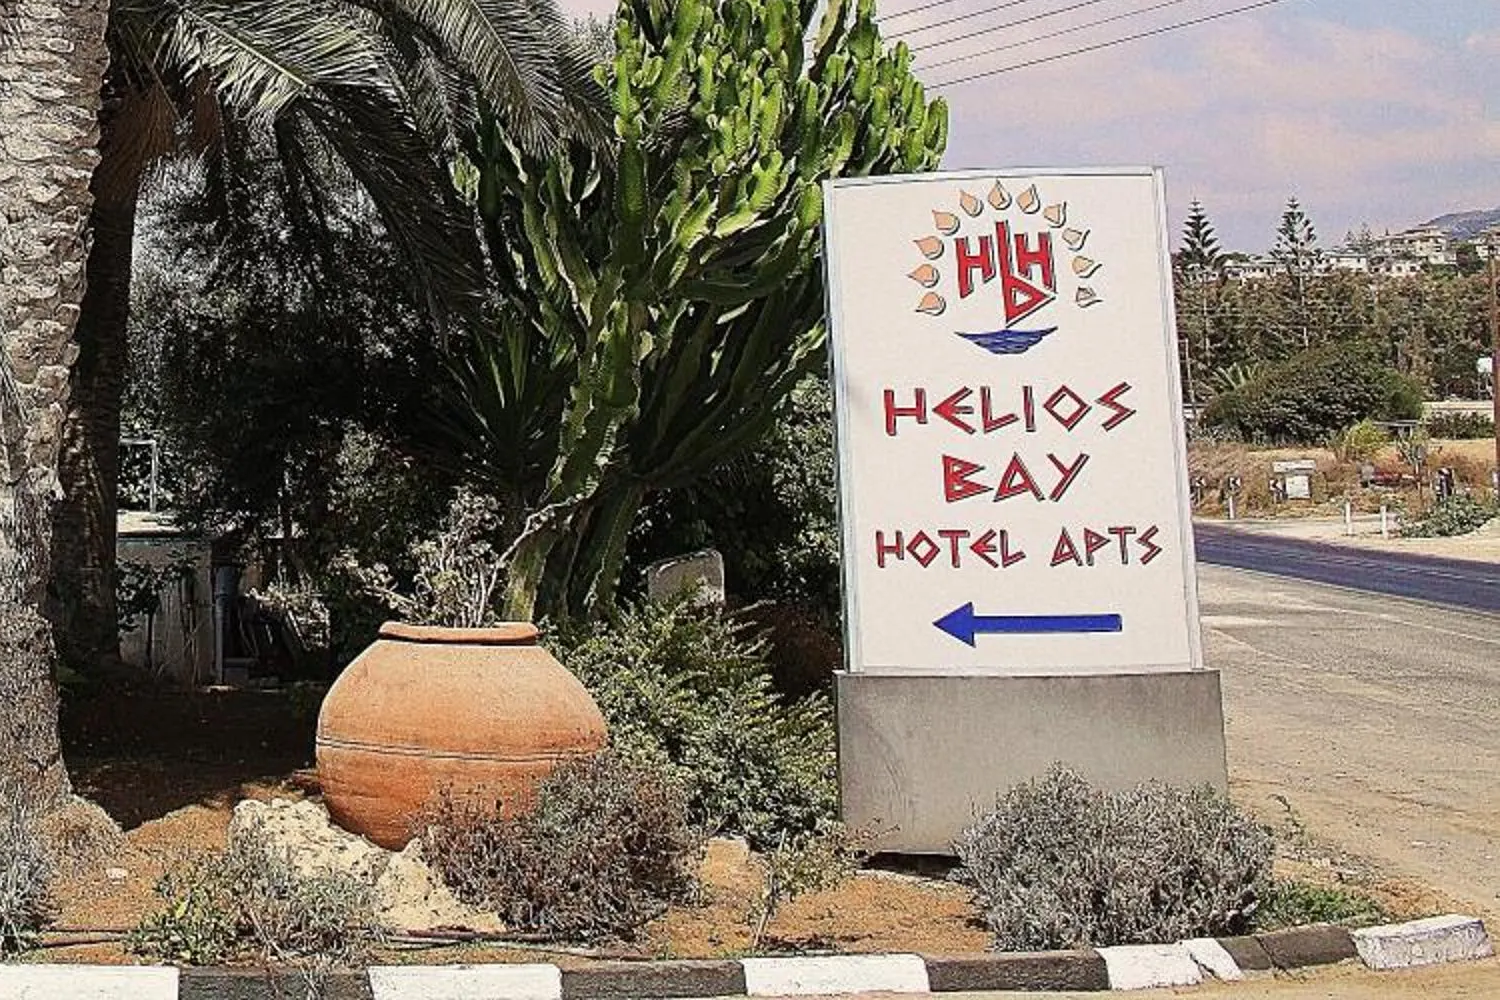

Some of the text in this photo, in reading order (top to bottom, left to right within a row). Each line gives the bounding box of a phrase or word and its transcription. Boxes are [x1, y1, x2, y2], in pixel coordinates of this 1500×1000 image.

[884, 382, 1137, 436] HELIOS
[942, 452, 1090, 503] BAY
[876, 526, 1163, 568] HOTEL APTS
